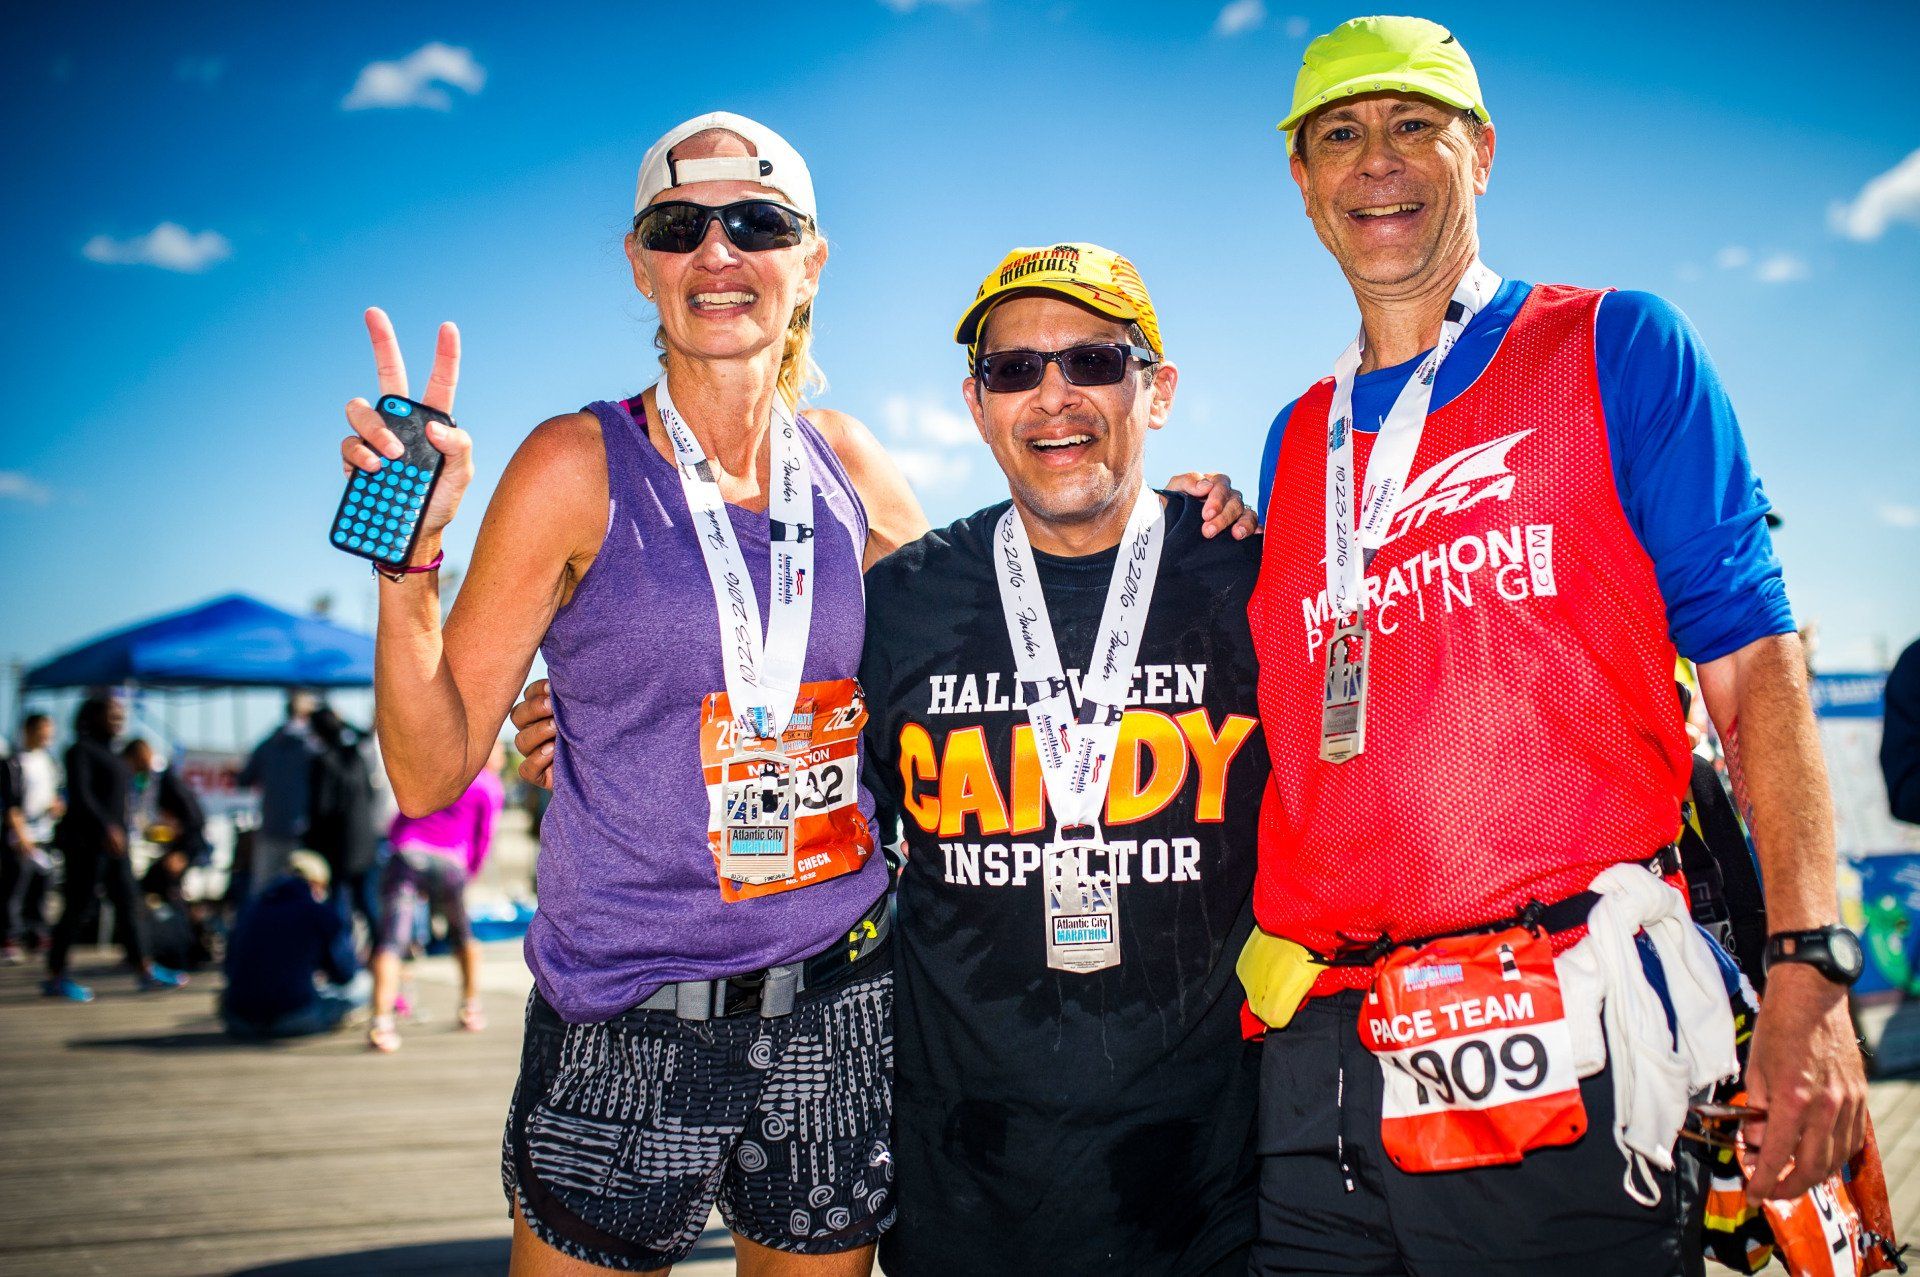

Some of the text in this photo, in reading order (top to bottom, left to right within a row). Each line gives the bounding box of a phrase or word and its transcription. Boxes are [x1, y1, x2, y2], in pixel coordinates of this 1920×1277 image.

[1302, 526, 1524, 632] MRATHON
[1307, 563, 1529, 663] PCING
[1043, 714, 1061, 769] AmeriHealth
[1075, 738, 1096, 794] AmeriHealth
[732, 828, 784, 842] Atlantic City
[797, 852, 832, 873] CHECK
[1057, 917, 1108, 930] Atlantic City
[1057, 929, 1108, 943] MARATHON
[1369, 992, 1535, 1045] PACE TEAM
